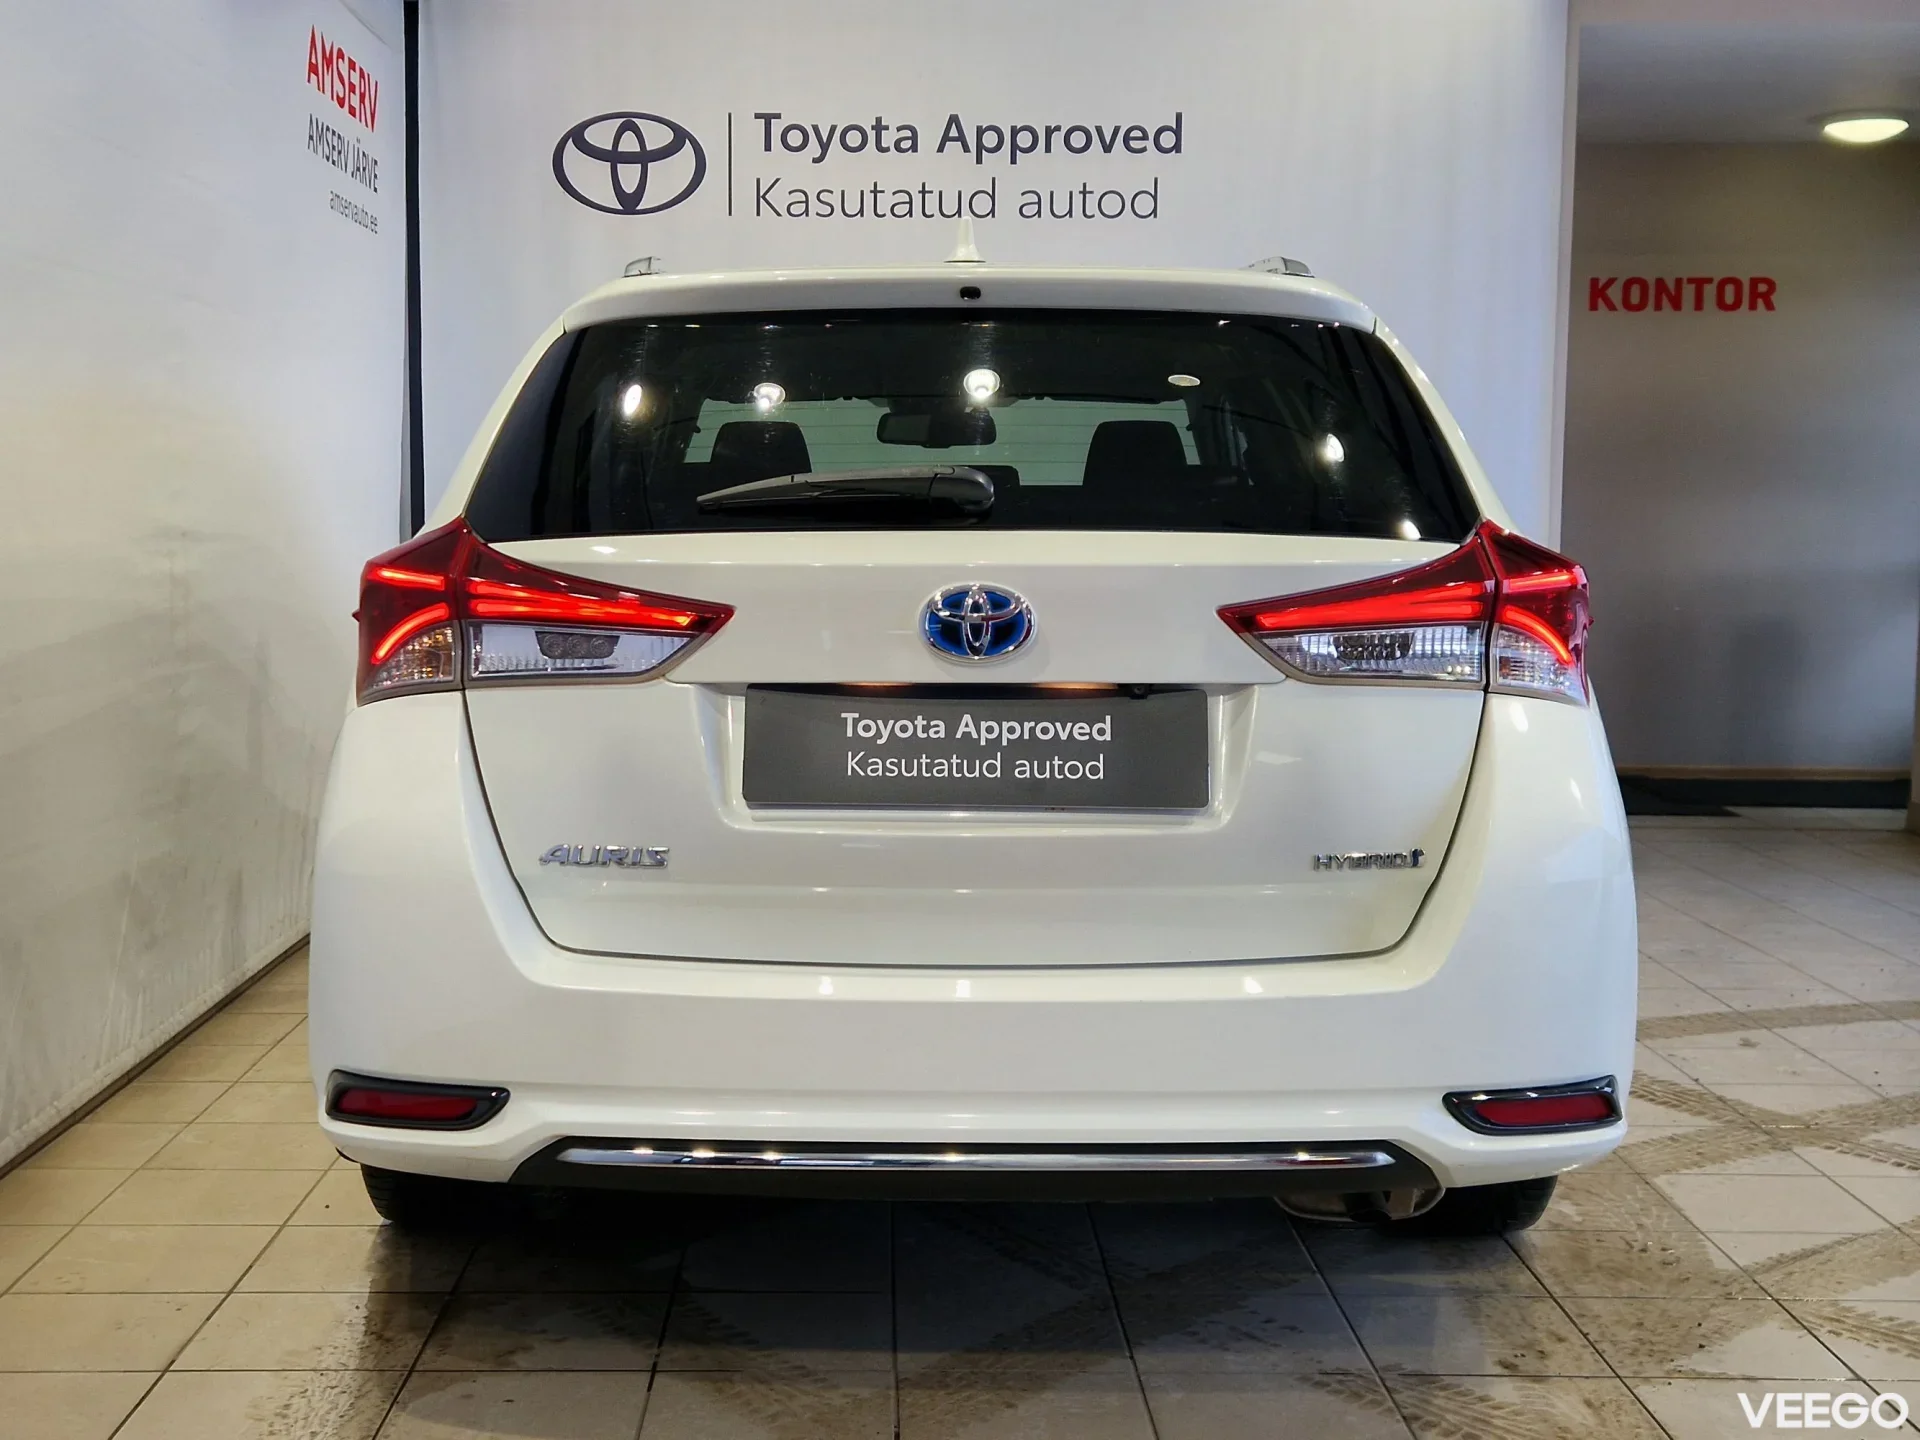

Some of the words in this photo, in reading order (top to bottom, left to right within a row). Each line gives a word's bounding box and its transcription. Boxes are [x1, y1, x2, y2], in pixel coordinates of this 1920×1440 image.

[307, 24, 379, 133] AMSERV
[307, 113, 350, 174] AMSERV
[351, 137, 378, 194] JÄRVE
[754, 113, 919, 164] Toyota
[936, 112, 1184, 165] Approved
[329, 190, 378, 235] amservauto.ee
[754, 177, 997, 219] Kasutatud
[1018, 177, 1159, 219] autod
[1588, 276, 1777, 312] KONTOR
[841, 712, 946, 745] Toyota
[956, 713, 1112, 746] Approved
[846, 751, 1002, 778] Kasutatud
[1014, 754, 1105, 780] autod
[538, 843, 670, 869] AURIS
[1313, 852, 1408, 871] HYBRID
